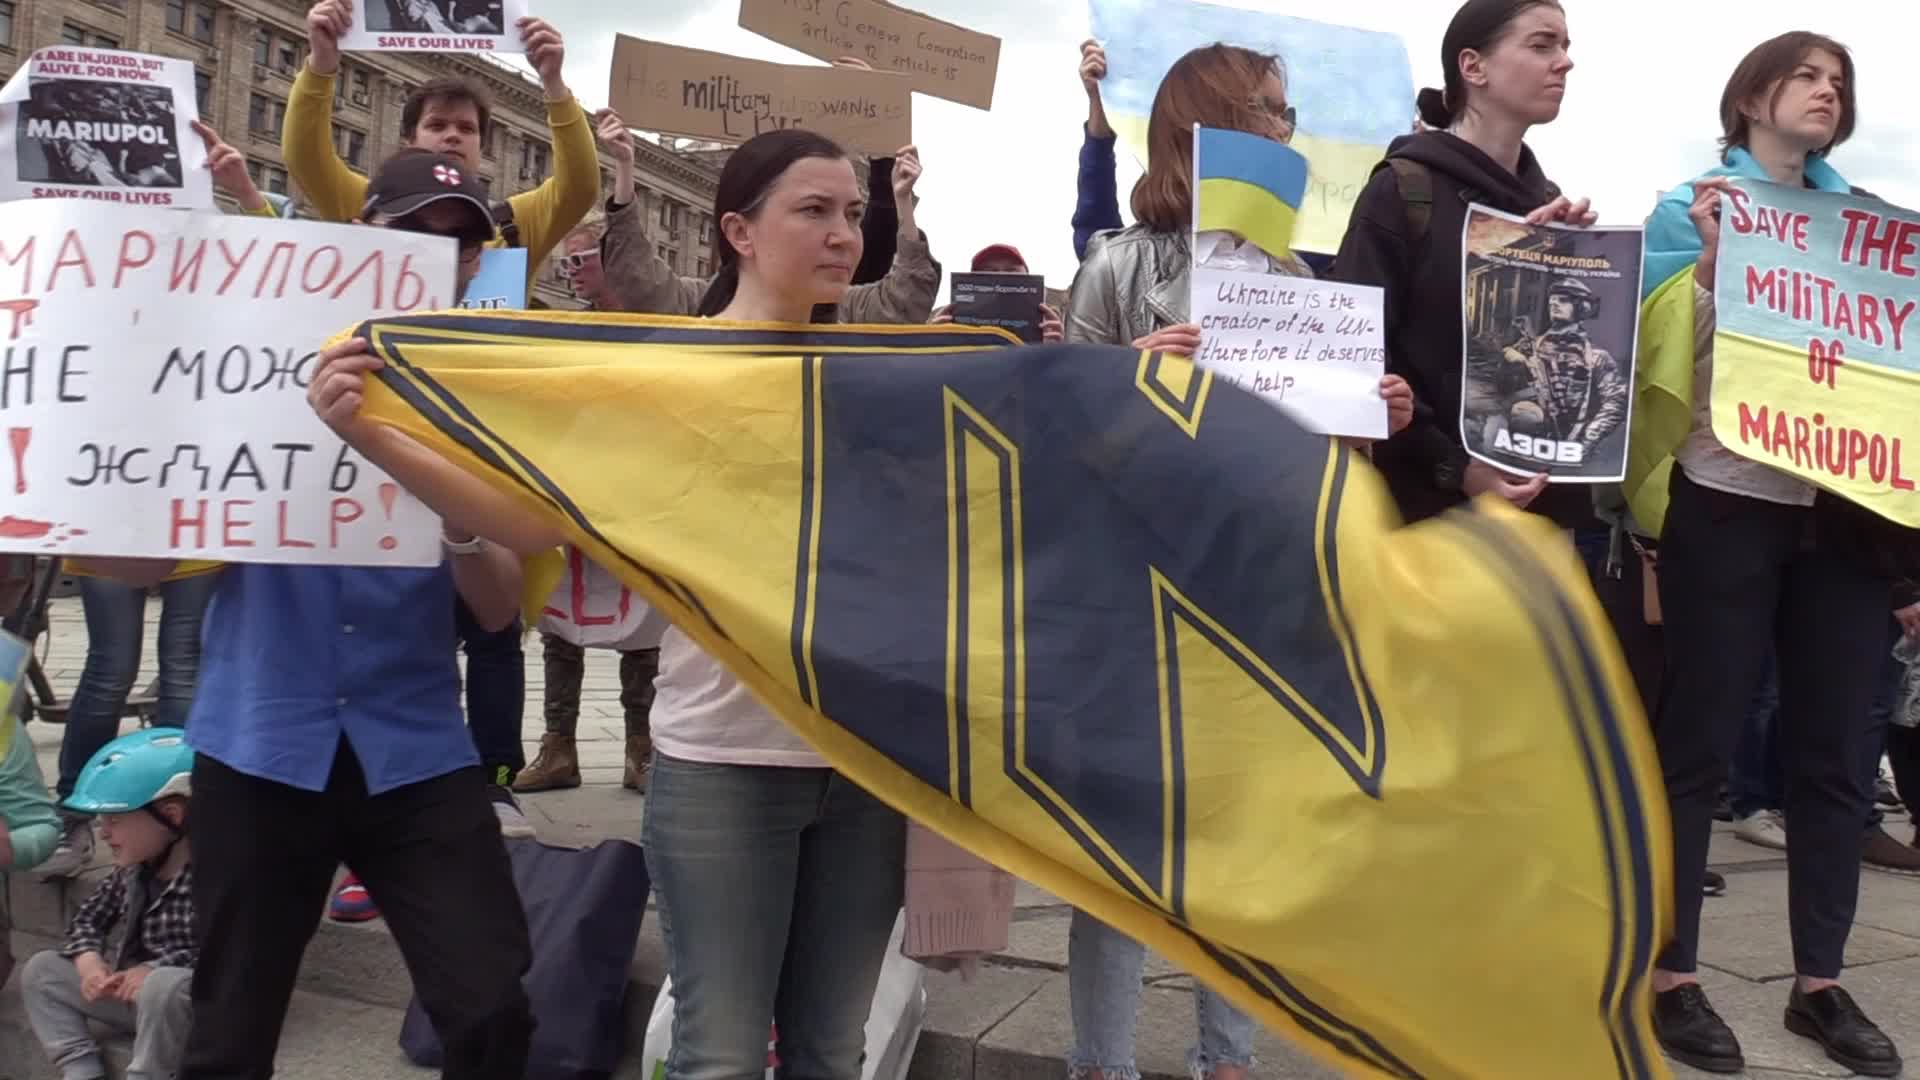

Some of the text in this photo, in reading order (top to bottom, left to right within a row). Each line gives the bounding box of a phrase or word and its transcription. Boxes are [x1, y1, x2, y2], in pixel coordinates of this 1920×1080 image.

[378, 37, 495, 50] SAVE OUR LIVES
[38, 62, 86, 76] ALIVE.
[88, 65, 116, 78] FOR
[47, 50, 75, 61] ARE
[78, 52, 141, 69] INJURED,
[26, 117, 169, 145] MARIUPOL
[125, 191, 173, 206] LIVES
[1730, 187, 1920, 278] SAVE THE
[1216, 281, 1356, 310] Ukraine is the
[1201, 311, 1270, 332] creator
[1275, 312, 1298, 332] of
[1298, 315, 1326, 336] the
[1316, 344, 1386, 364] deserves
[0, 343, 321, 409] НЕ МОЖ
[1252, 370, 1295, 401] help
[1493, 428, 1584, 463] АЗОВ
[65, 441, 361, 494] ЖДАТЬ
